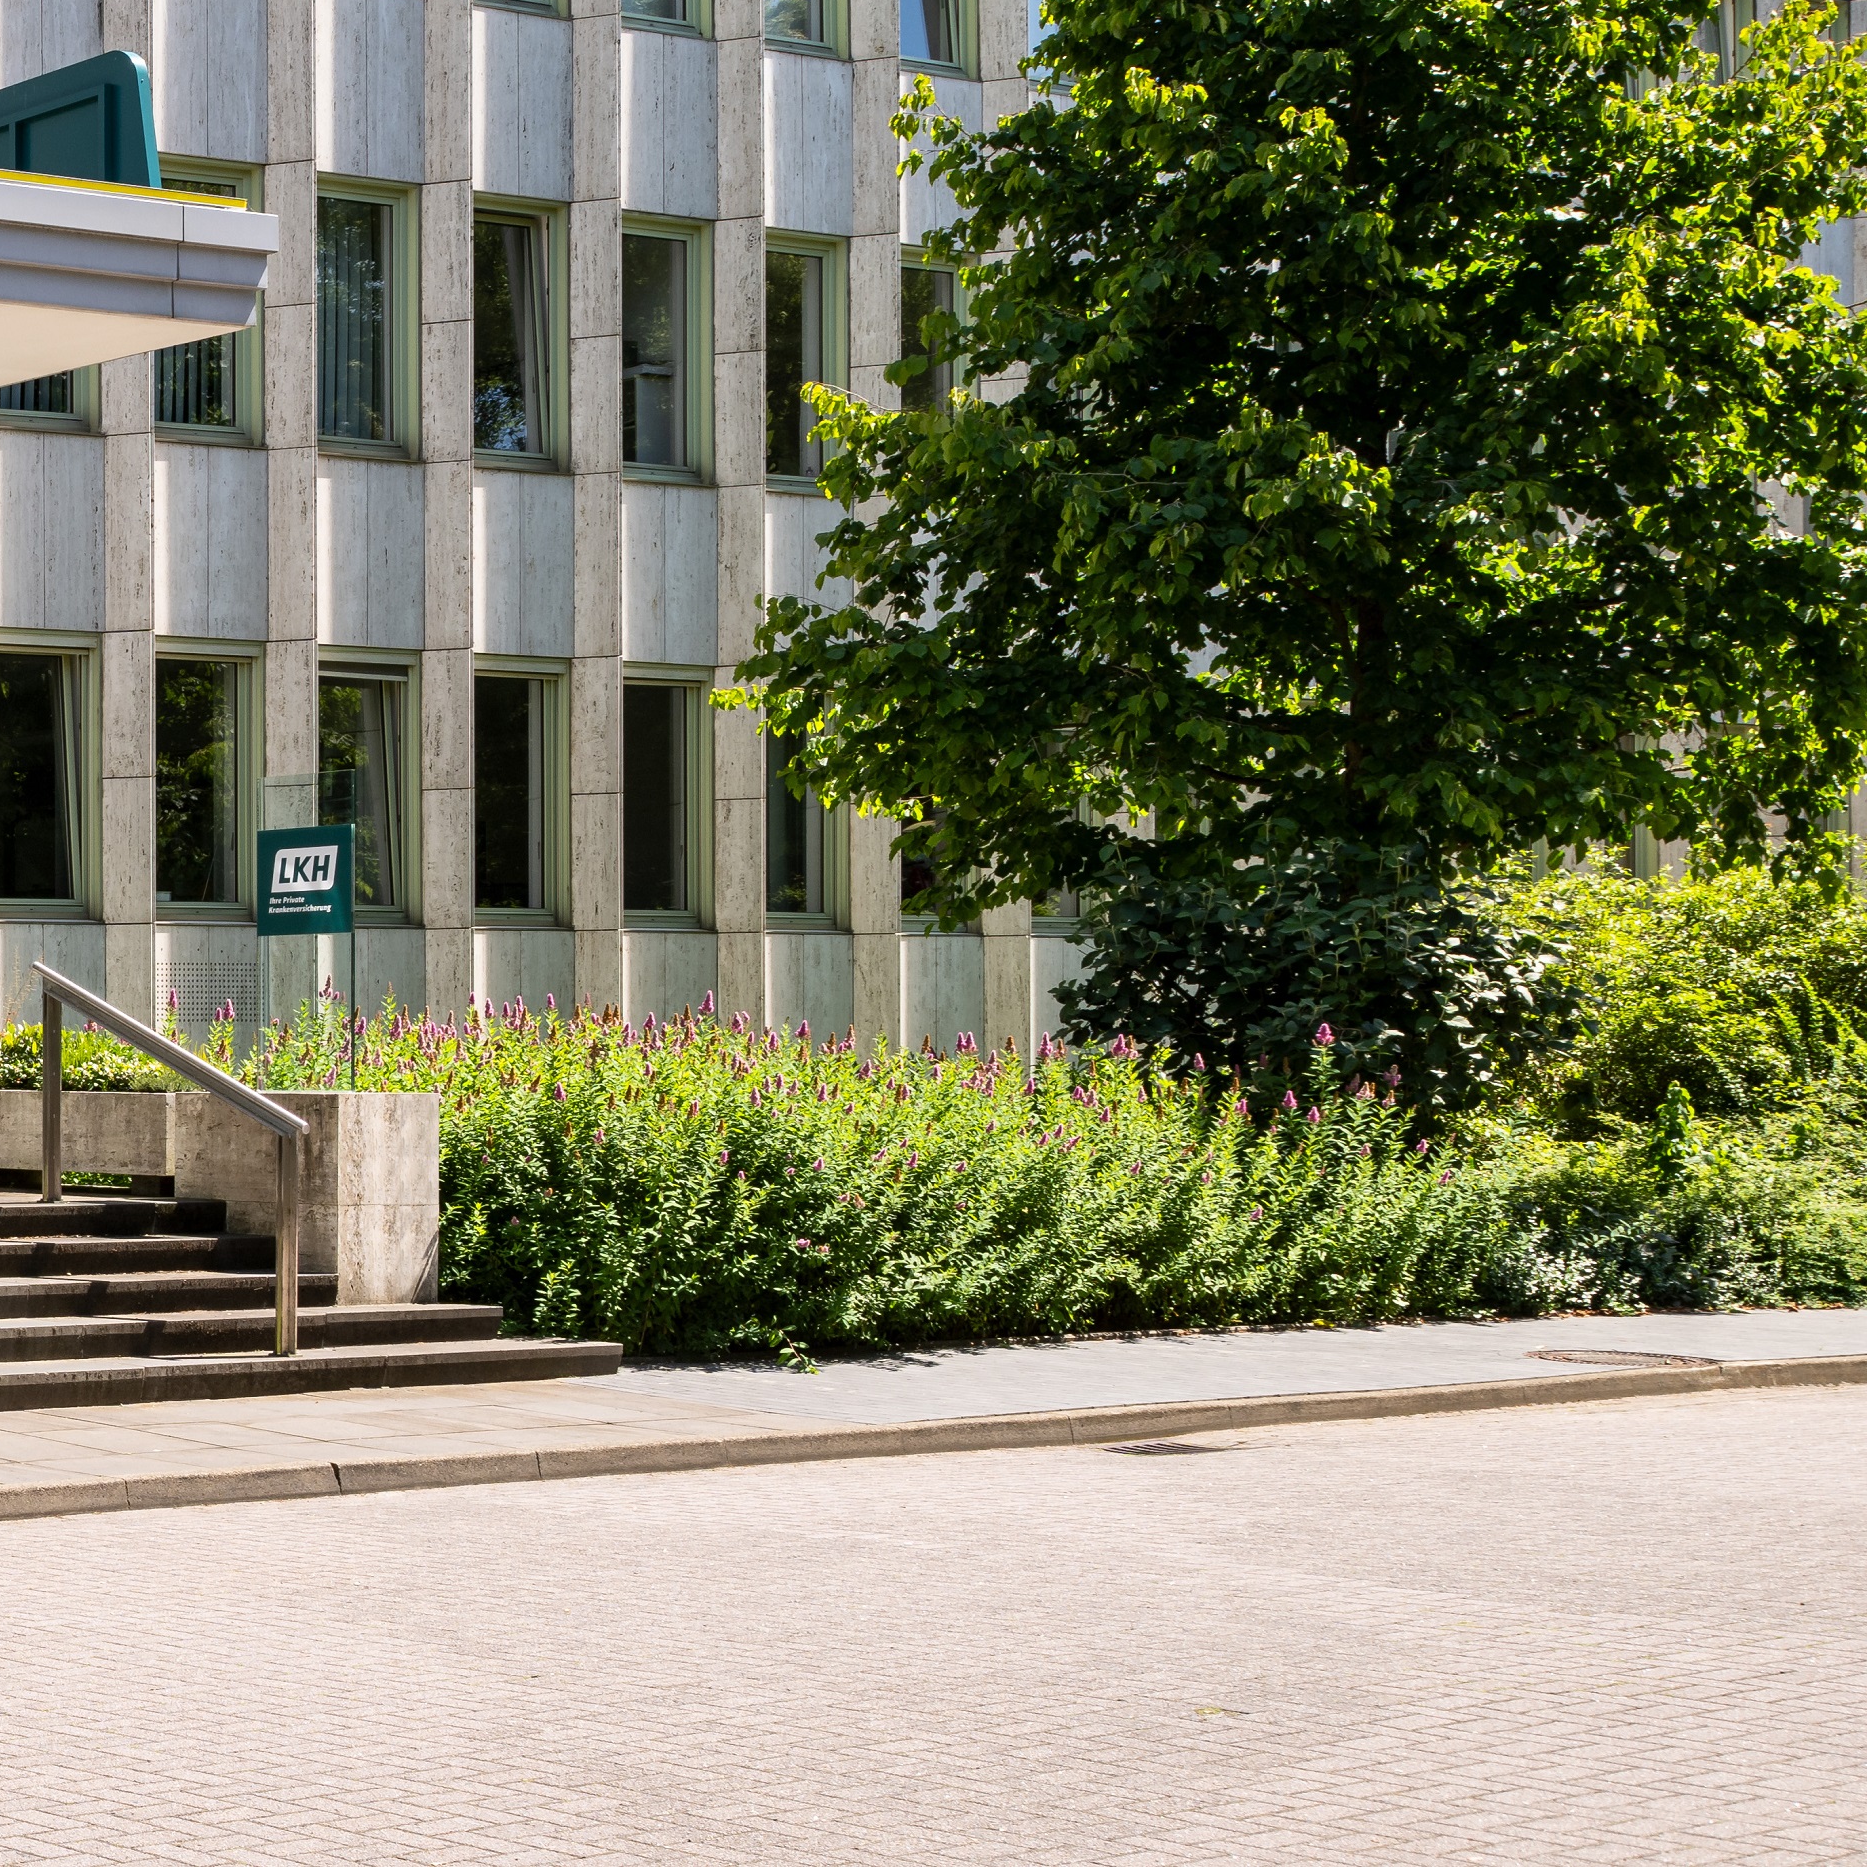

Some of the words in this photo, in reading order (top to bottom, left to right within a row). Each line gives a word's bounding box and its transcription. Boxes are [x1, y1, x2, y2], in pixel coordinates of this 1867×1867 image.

[278, 854, 331, 884] LKH
[283, 896, 305, 904] Private
[268, 904, 332, 914] Krankenversicherung
